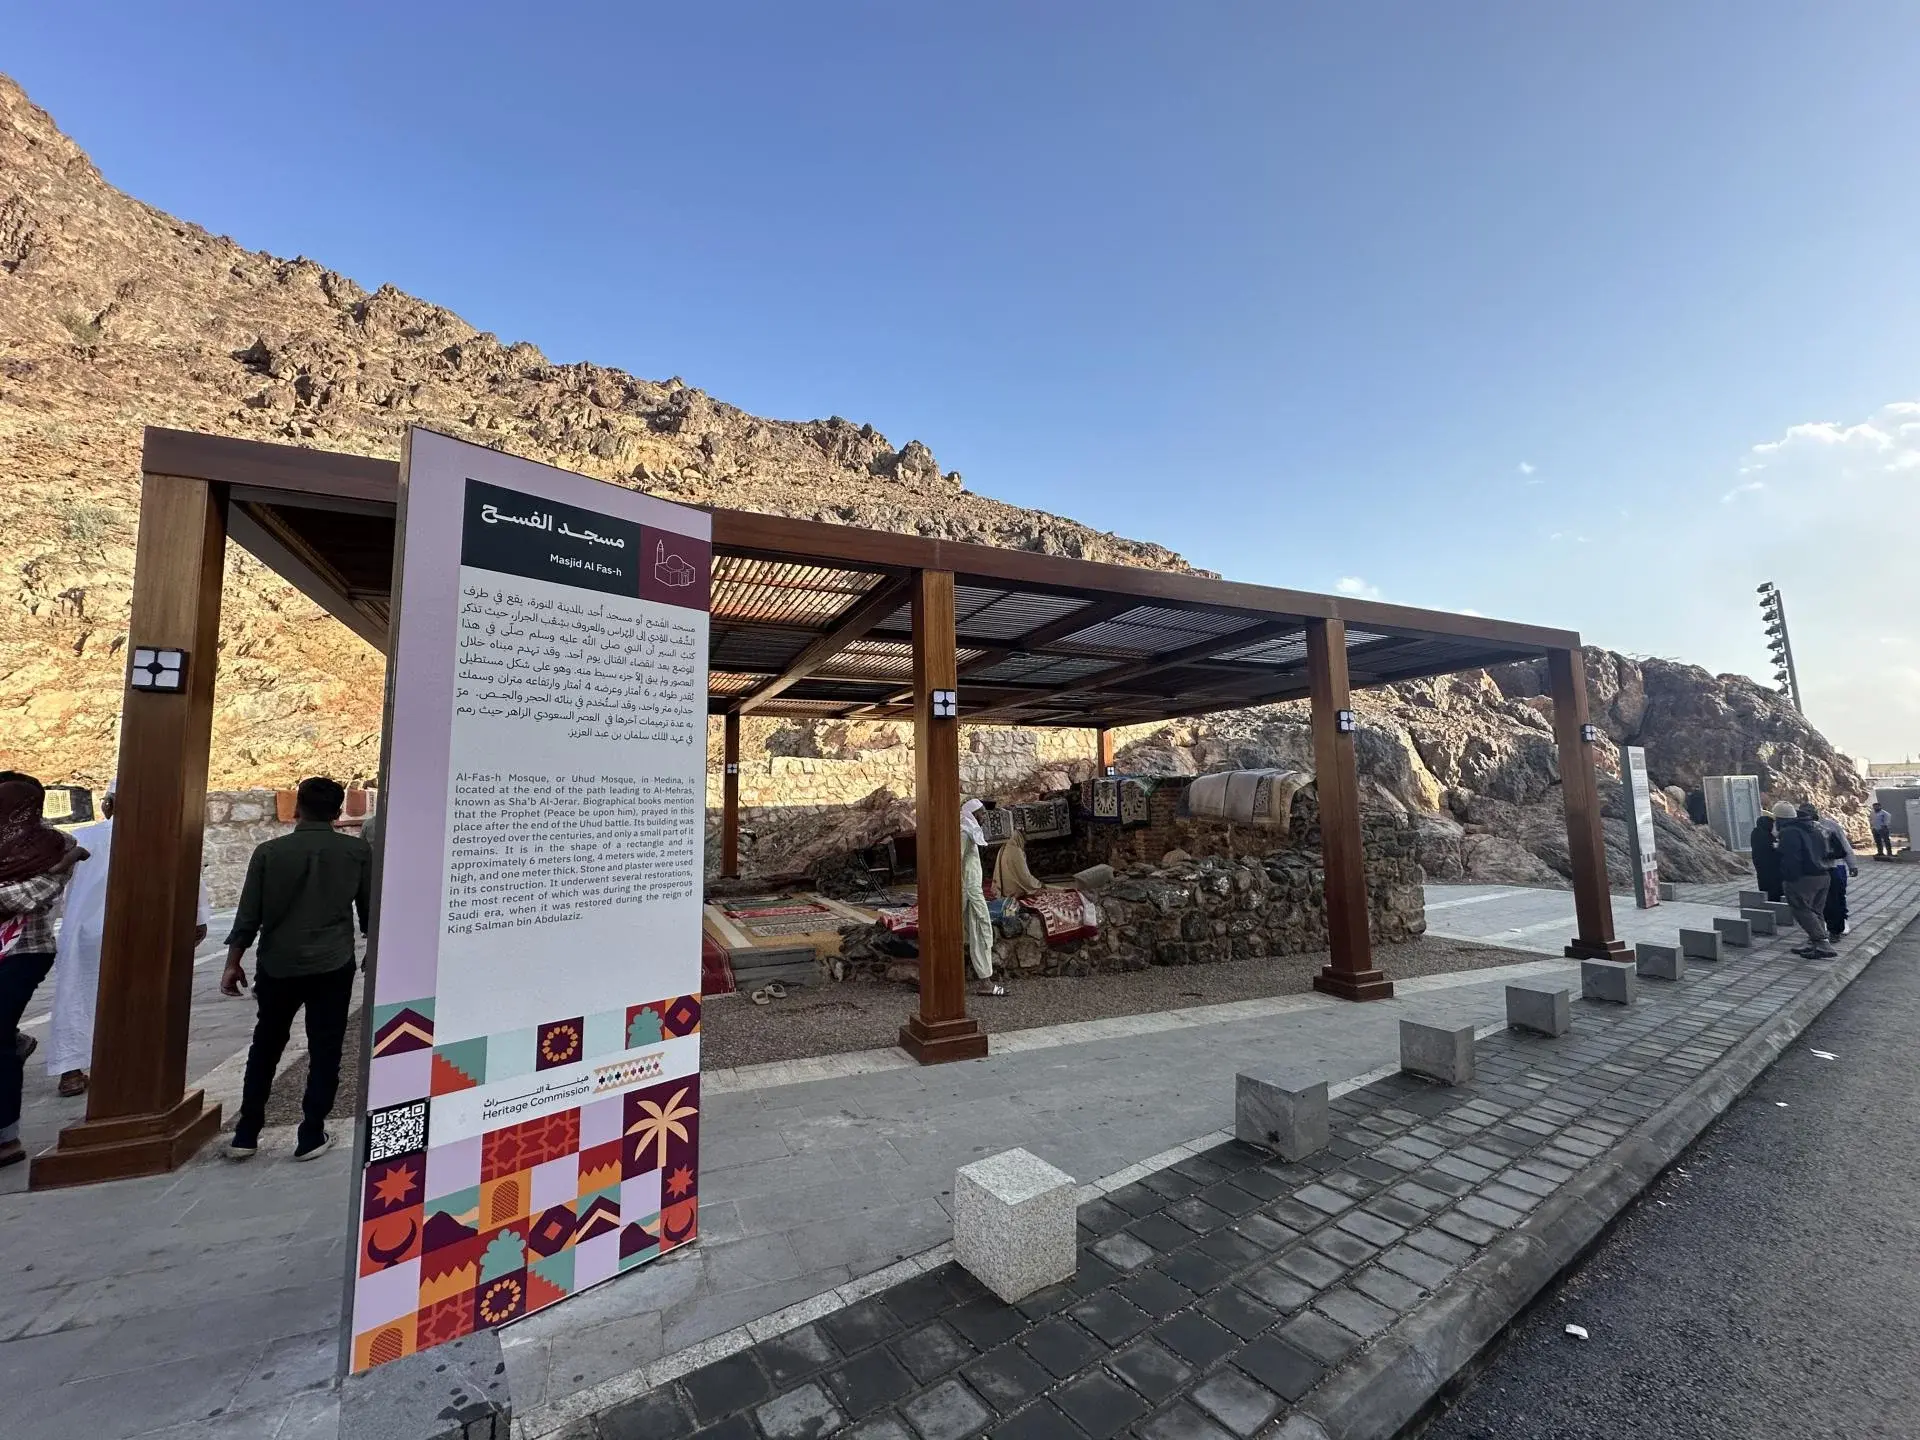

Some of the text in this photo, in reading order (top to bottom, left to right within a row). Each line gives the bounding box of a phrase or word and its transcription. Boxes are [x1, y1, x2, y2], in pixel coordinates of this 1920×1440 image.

[481, 503, 625, 550] مسجد الفسح
[550, 554, 622, 577] Masjid Al Fas-h
[462, 618, 480, 630] هذا
[485, 622, 496, 637] في
[529, 629, 555, 643] وسلم
[560, 634, 578, 645] عليه
[582, 633, 596, 647] الله
[456, 707, 476, 716] رمم
[478, 706, 503, 717] حيث
[534, 711, 575, 722] السعودي
[576, 712, 600, 724] العصر
[604, 714, 613, 727] في
[670, 720, 684, 728] عدة
[594, 730, 609, 739] عبد
[624, 730, 650, 741] سلمان
[670, 734, 684, 743] عهد
[686, 735, 693, 746] في
[456, 772, 501, 782] Al-Fas-h
[508, 773, 549, 784] Mosque,
[572, 774, 595, 783] Uhud
[601, 776, 636, 785] Mosque,
[455, 785, 495, 794] located
[499, 786, 509, 794] at
[514, 785, 530, 794] the
[534, 785, 552, 794] end
[555, 785, 565, 794] of
[568, 786, 583, 794] the
[586, 786, 606, 796] path
[610, 786, 640, 796] leading
[455, 797, 490, 806] known
[508, 797, 537, 806] Sha'b
[539, 797, 580, 805] Al-Jerar.
[583, 797, 636, 807] Biographical
[638, 797, 662, 805] books
[454, 810, 476, 819] that
[479, 810, 497, 818] the
[501, 809, 540, 820] Prophet
[544, 808, 576, 819] (Peace
[578, 808, 590, 817] be
[593, 810, 615, 818] upon
[617, 808, 639, 816] him),
[641, 807, 668, 817] prayed
[453, 822, 483, 834] place
[484, 821, 510, 830] after
[512, 821, 529, 830] the
[530, 820, 549, 829] end
[550, 820, 561, 829] of
[562, 820, 578, 828] the
[580, 819, 603, 828] Uhud
[604, 818, 632, 827] battle.
[634, 818, 645, 826] Its
[646, 818, 678, 828] building
[452, 834, 506, 846] destroyed
[532, 832, 548, 841] the
[550, 831, 594, 841] centuries,
[596, 830, 612, 839] and
[614, 829, 632, 840] only
[640, 828, 661, 837] small
[663, 829, 678, 838] part
[452, 846, 498, 857] remains.
[505, 845, 514, 854] It
[520, 845, 528, 854] is
[535, 844, 543, 853] in
[550, 843, 564, 852] the
[570, 842, 597, 853] shape
[602, 841, 611, 850] of
[627, 839, 664, 850] rectangle
[669, 838, 682, 846] and
[451, 857, 526, 871] approximately
[529, 856, 535, 865] 6
[538, 855, 571, 864] meters
[573, 853, 595, 864] long,
[597, 852, 603, 861] 4
[605, 852, 635, 860] meters
[637, 850, 658, 859] wide,
[450, 872, 477, 884] high,
[479, 870, 499, 880] and
[522, 868, 551, 877] meter
[553, 866, 578, 875] thick.
[580, 864, 606, 874] Stone
[607, 863, 623, 872] and
[624, 861, 653, 872] plaster
[675, 858, 693, 867] used
[450, 886, 460, 895] in
[463, 884, 477, 894] its
[480, 880, 546, 893] construction.
[550, 879, 558, 887] It
[561, 875, 609, 886] underwent
[612, 872, 642, 882] several
[449, 899, 467, 908] the
[472, 896, 498, 906] most
[502, 893, 534, 903] recent
[538, 891, 548, 900] of
[552, 889, 579, 899] which
[603, 885, 630, 896] during
[633, 883, 647, 892] the
[650, 881, 692, 892] prosperous
[448, 909, 479, 921] Saudi
[484, 909, 504, 918] era,
[509, 904, 536, 915] when
[541, 903, 547, 912] it
[575, 897, 612, 908] restored
[616, 894, 642, 904] during
[646, 893, 659, 901] the
[662, 891, 681, 900] reign
[685, 889, 692, 897] of
[448, 912, 583, 935] King Salman bin Abdulaziz.
[482, 1085, 590, 1120] Heritage Commission
